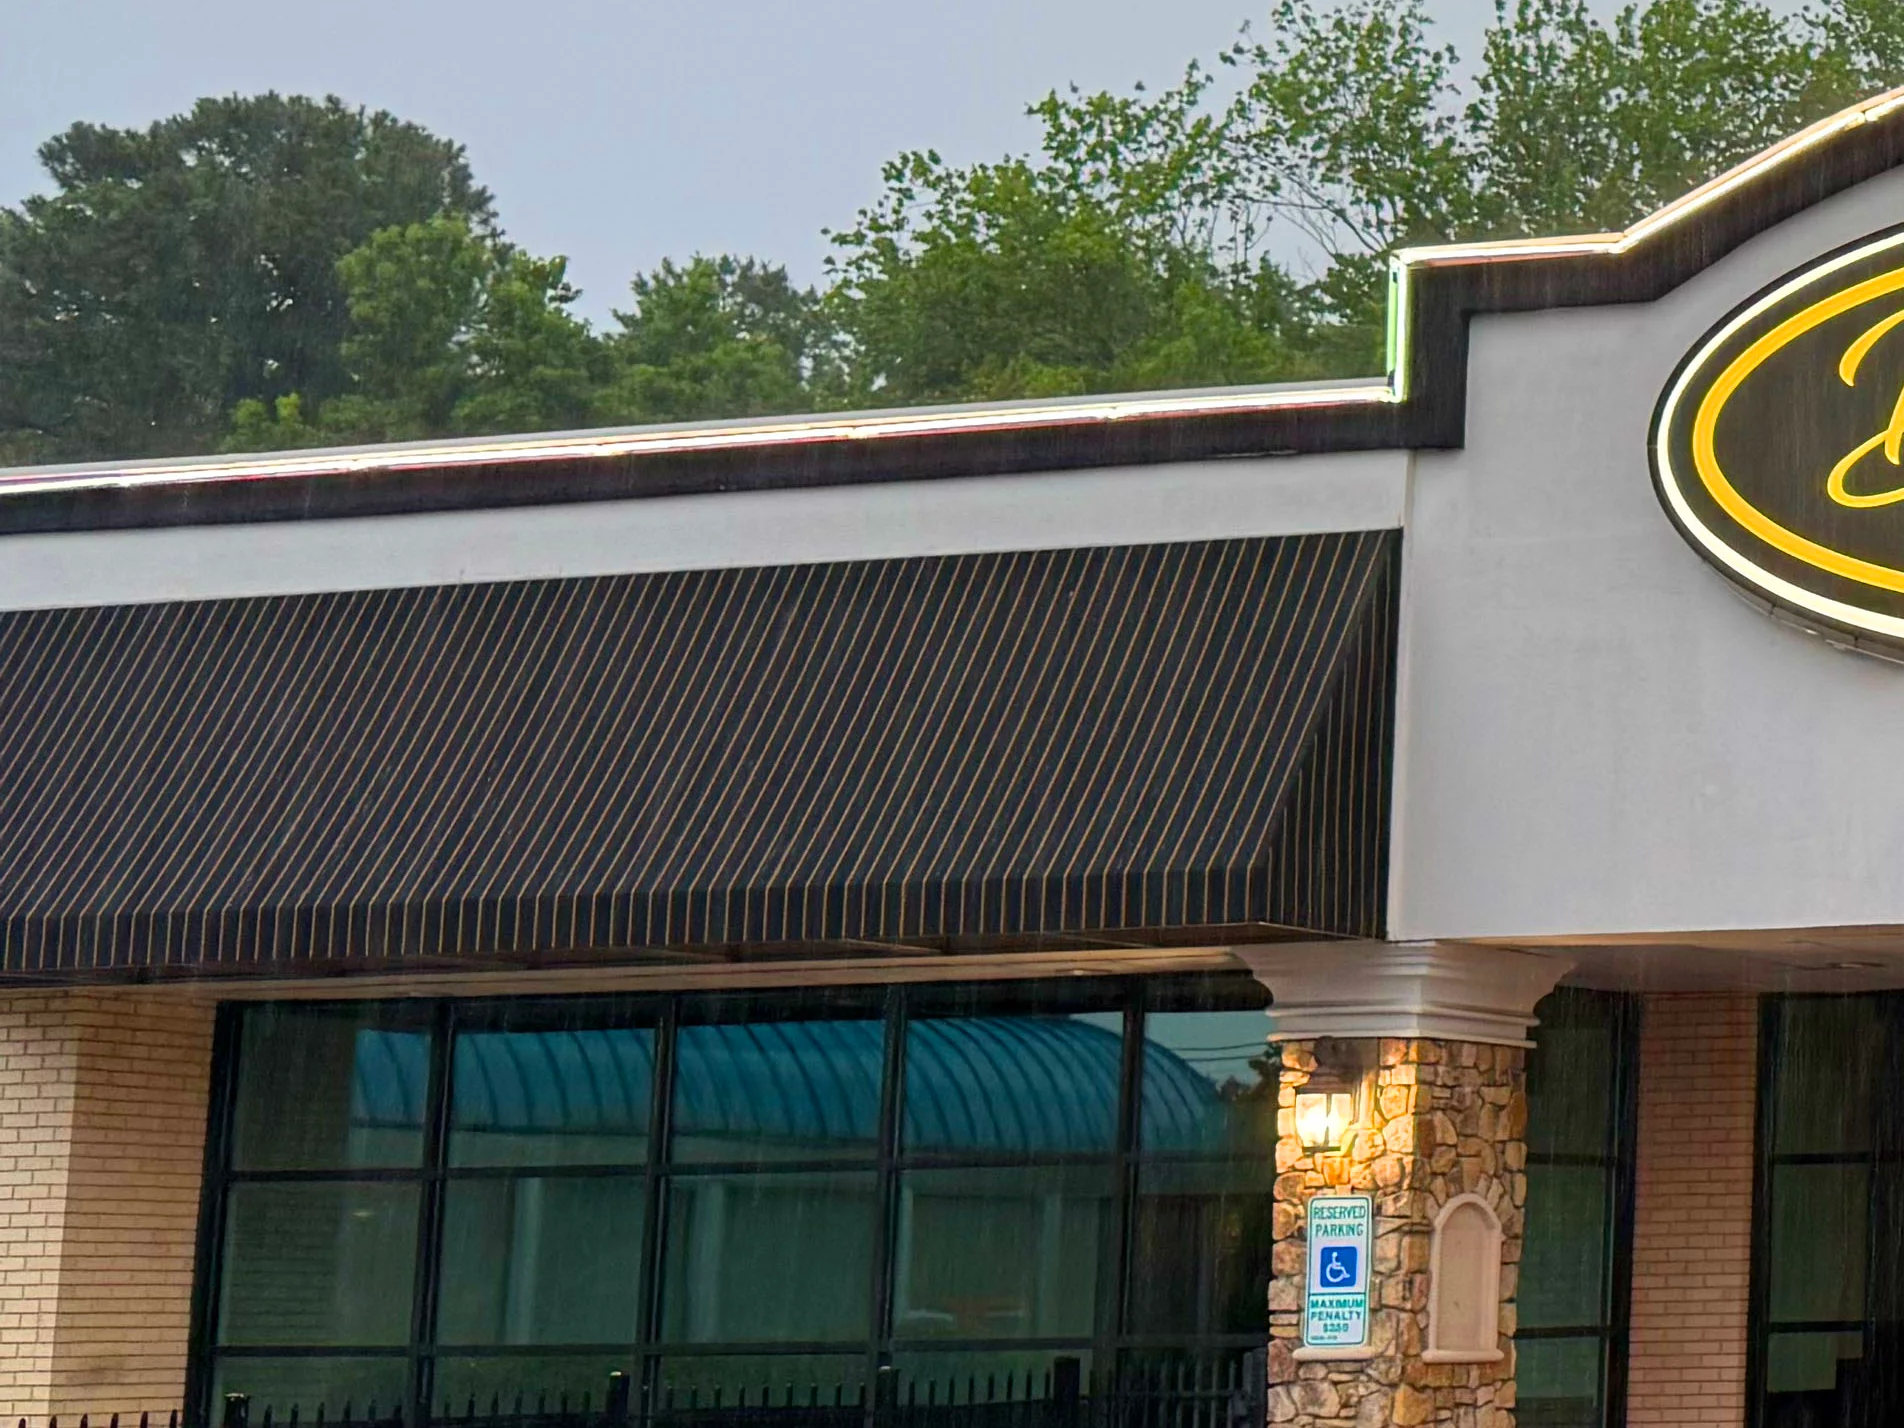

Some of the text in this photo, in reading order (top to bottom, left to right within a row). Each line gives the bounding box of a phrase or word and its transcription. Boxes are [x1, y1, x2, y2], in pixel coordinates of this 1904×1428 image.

[1313, 1206, 1366, 1219] RESERVED
[1315, 1223, 1364, 1237] PARKING
[1311, 1299, 1364, 1308] MAXIMUM
[1311, 1311, 1361, 1321] PENALTY
